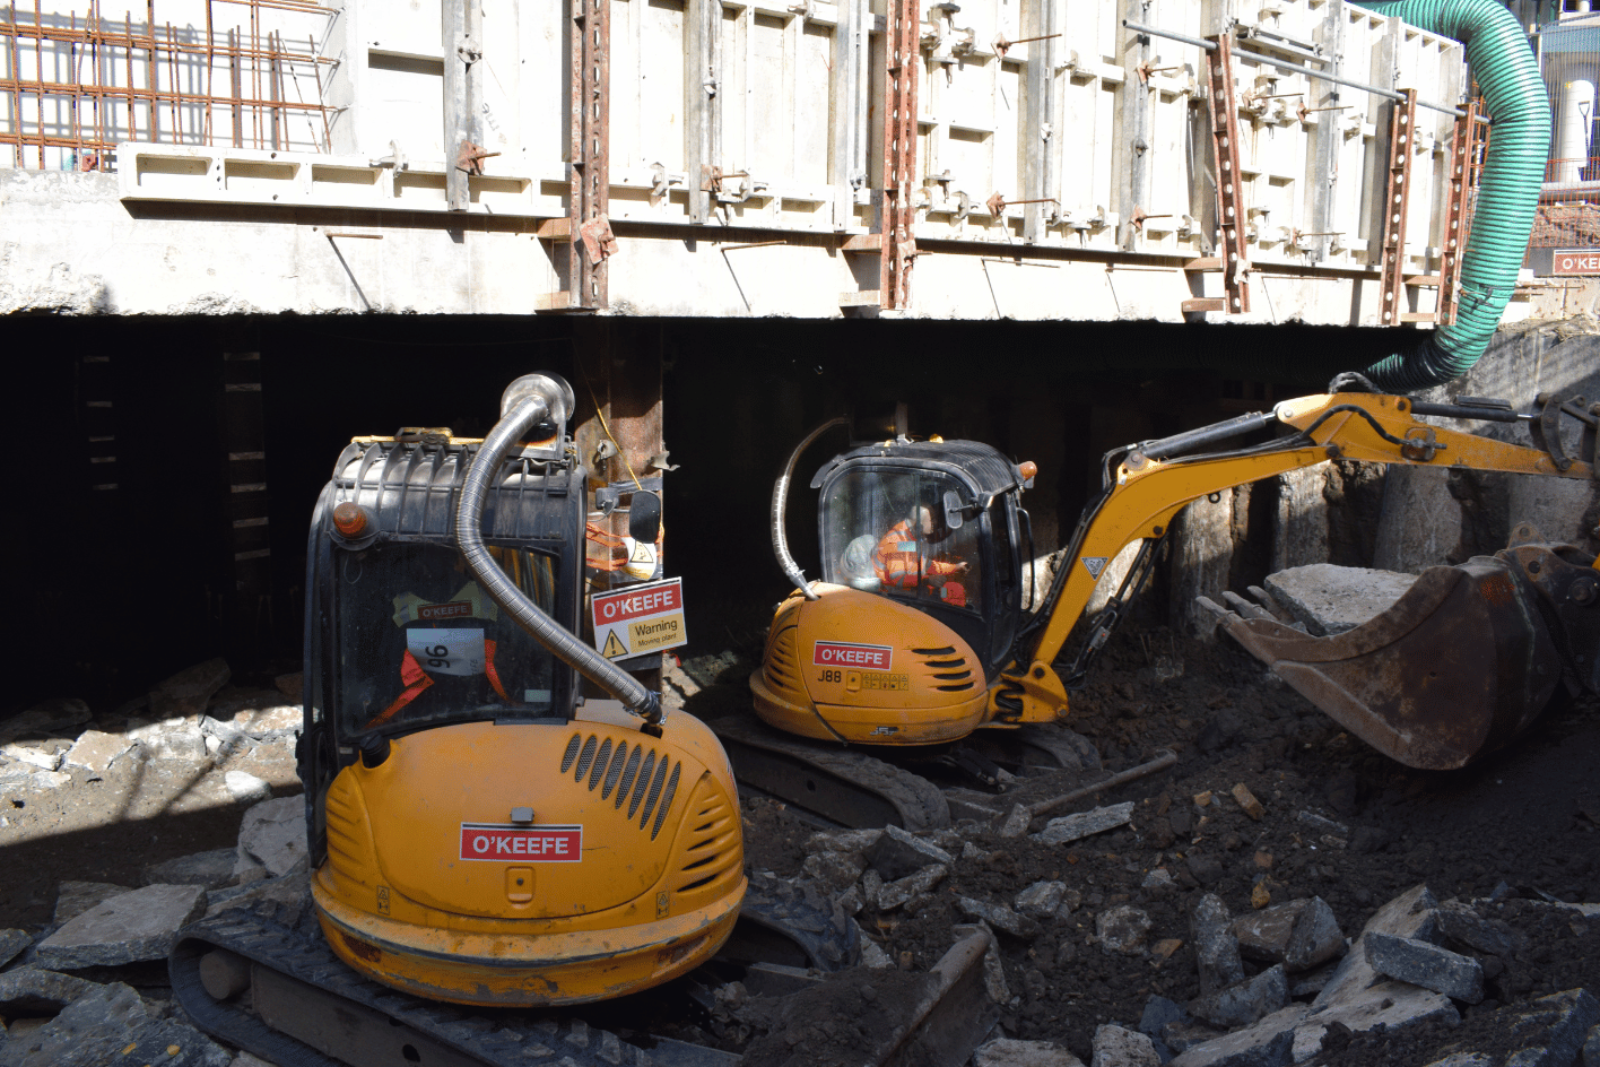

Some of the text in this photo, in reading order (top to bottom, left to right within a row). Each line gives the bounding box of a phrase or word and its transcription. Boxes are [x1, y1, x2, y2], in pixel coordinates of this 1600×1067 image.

[1562, 258, 1600, 270] O'KE
[422, 605, 468, 617] O'KEEFE
[603, 590, 673, 618] O'KEEFE
[635, 620, 677, 636] Warning
[638, 633, 677, 647] Moving plant
[821, 648, 883, 665] O'KEEFE
[817, 669, 842, 683] J88
[472, 835, 569, 854] O'KEEFE
